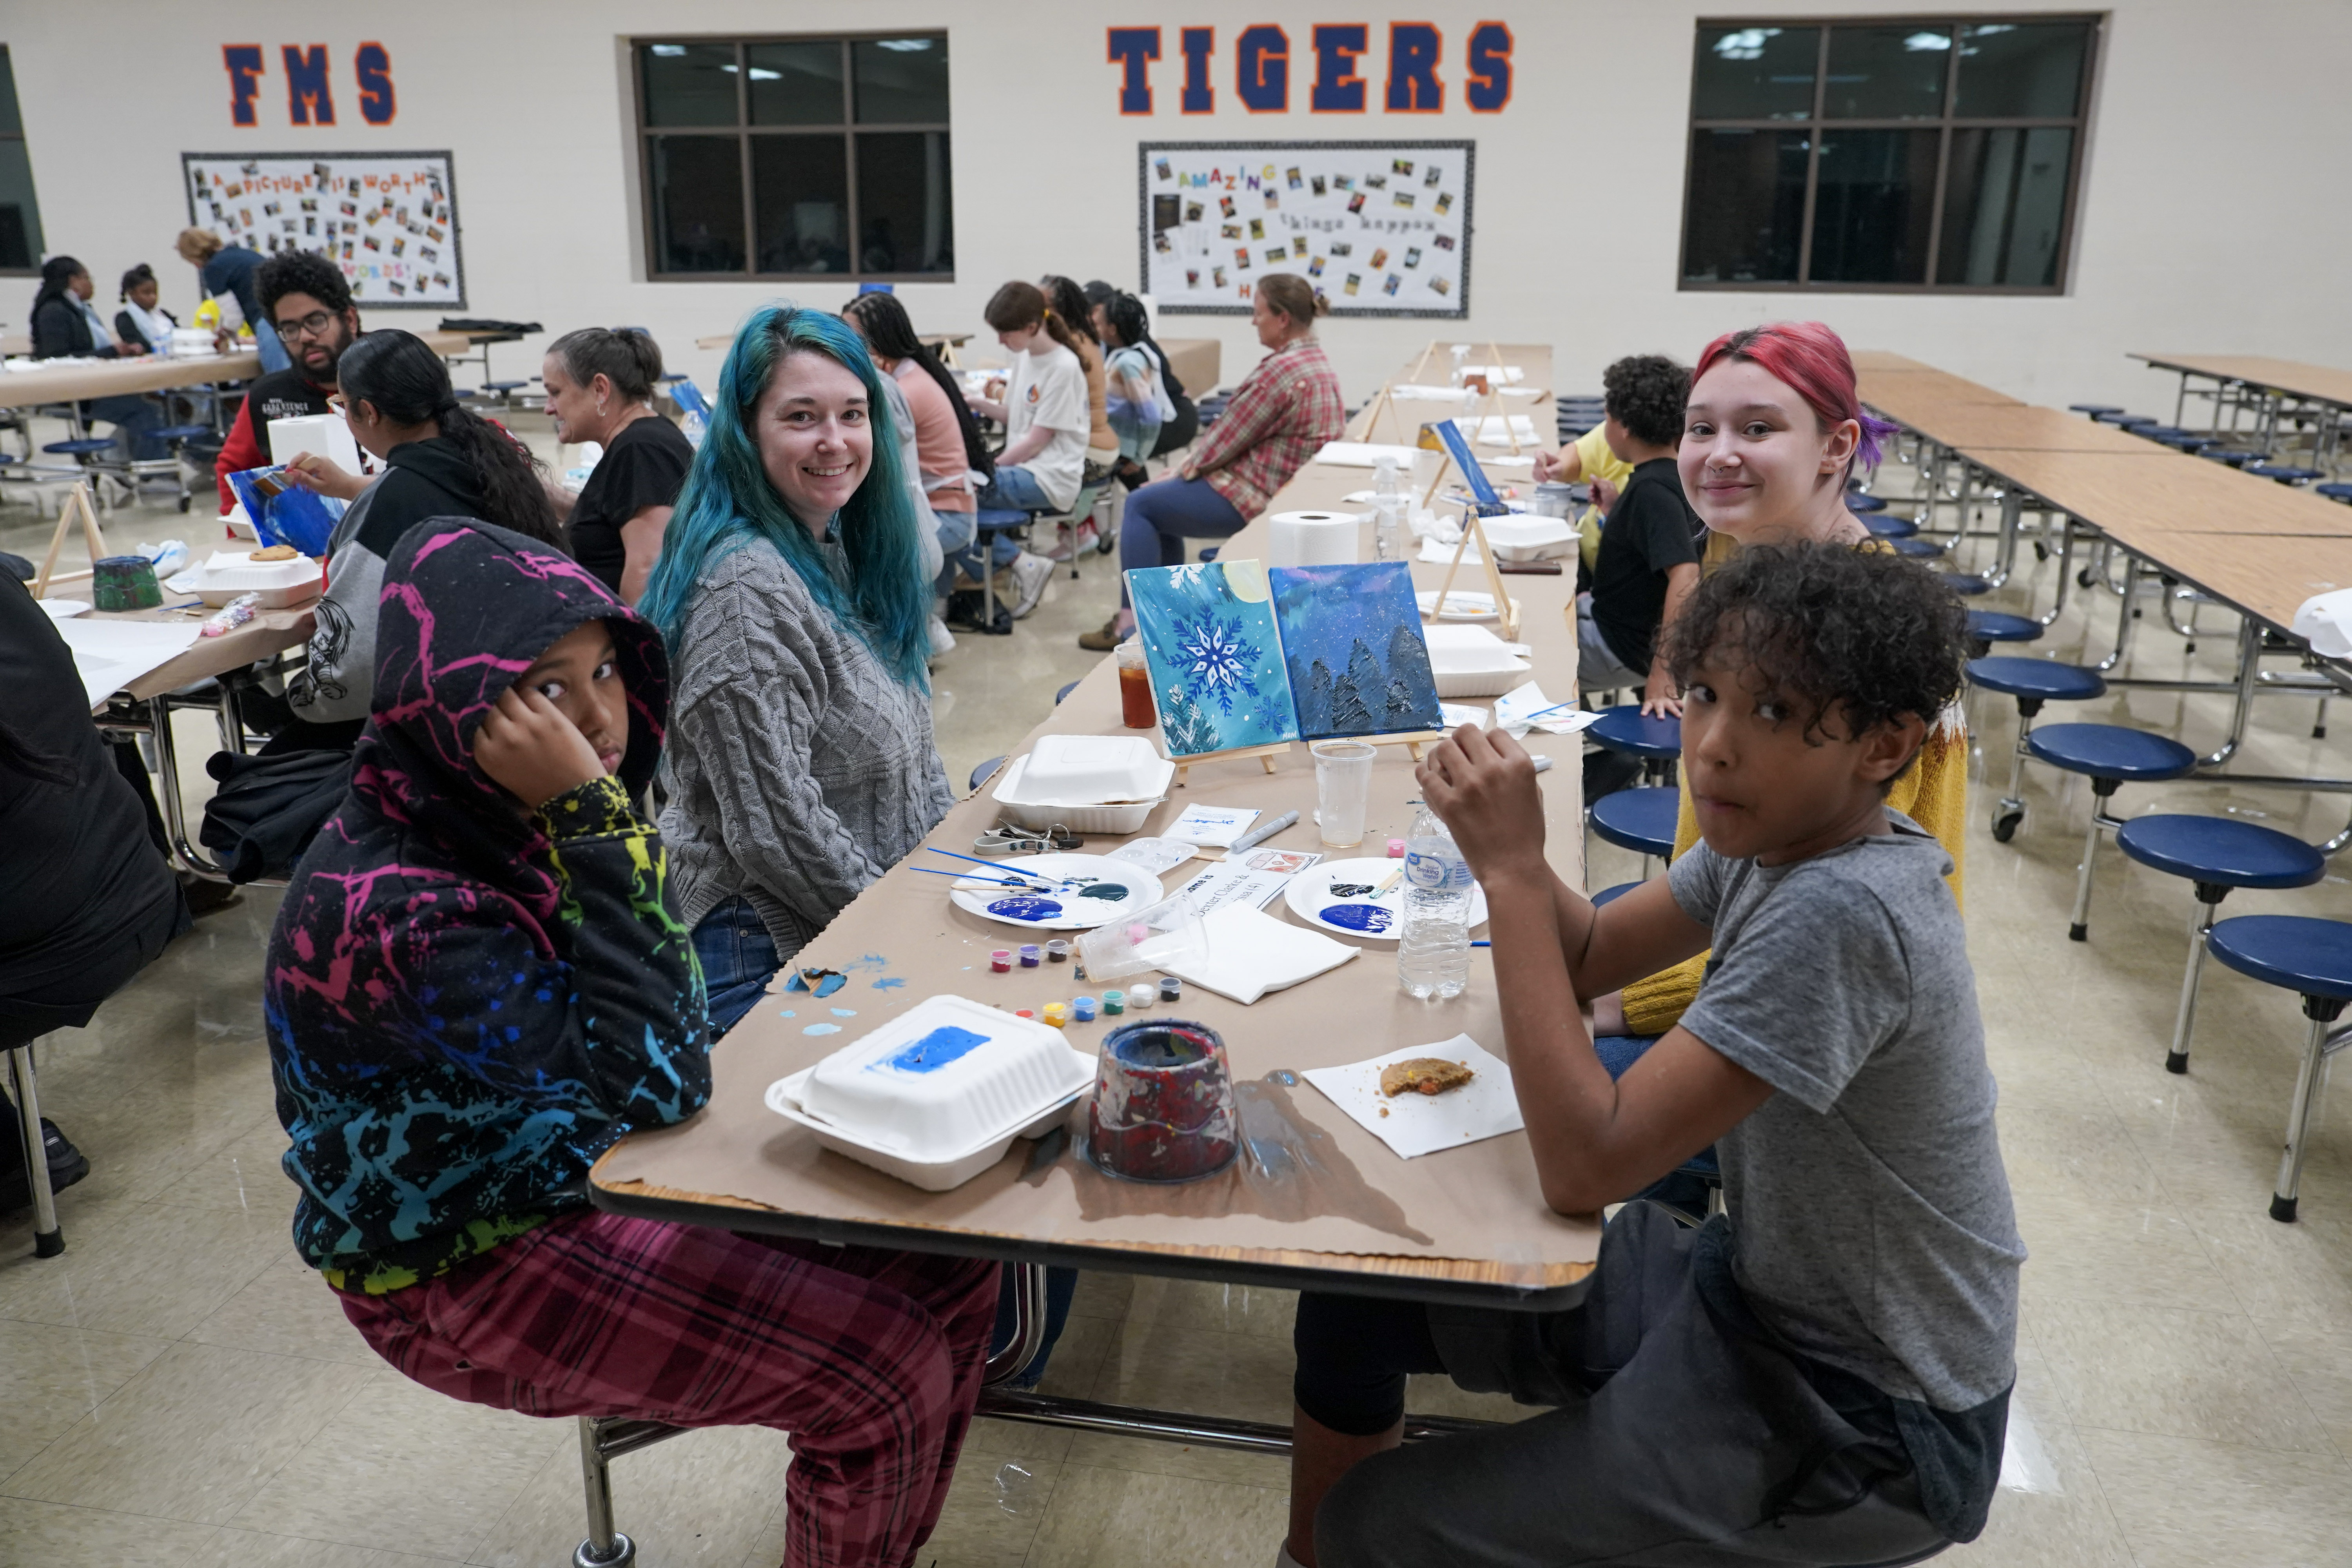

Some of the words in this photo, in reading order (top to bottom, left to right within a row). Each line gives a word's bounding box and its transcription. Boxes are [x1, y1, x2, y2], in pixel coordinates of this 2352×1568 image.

[1107, 20, 1514, 115] TIGERS
[222, 41, 397, 127] FMS
[213, 173, 223, 186] A
[244, 174, 313, 194] PICTURE
[363, 172, 426, 195] WORTH
[1179, 164, 1275, 190] AMAZING
[1280, 212, 1344, 233] things
[1282, 730, 1297, 740] MOM
[1417, 866, 1439, 876] Drinking
[1187, 879, 1207, 893] ame
[1190, 896, 1221, 917] Dexter
[1214, 880, 1242, 896] Clarke
